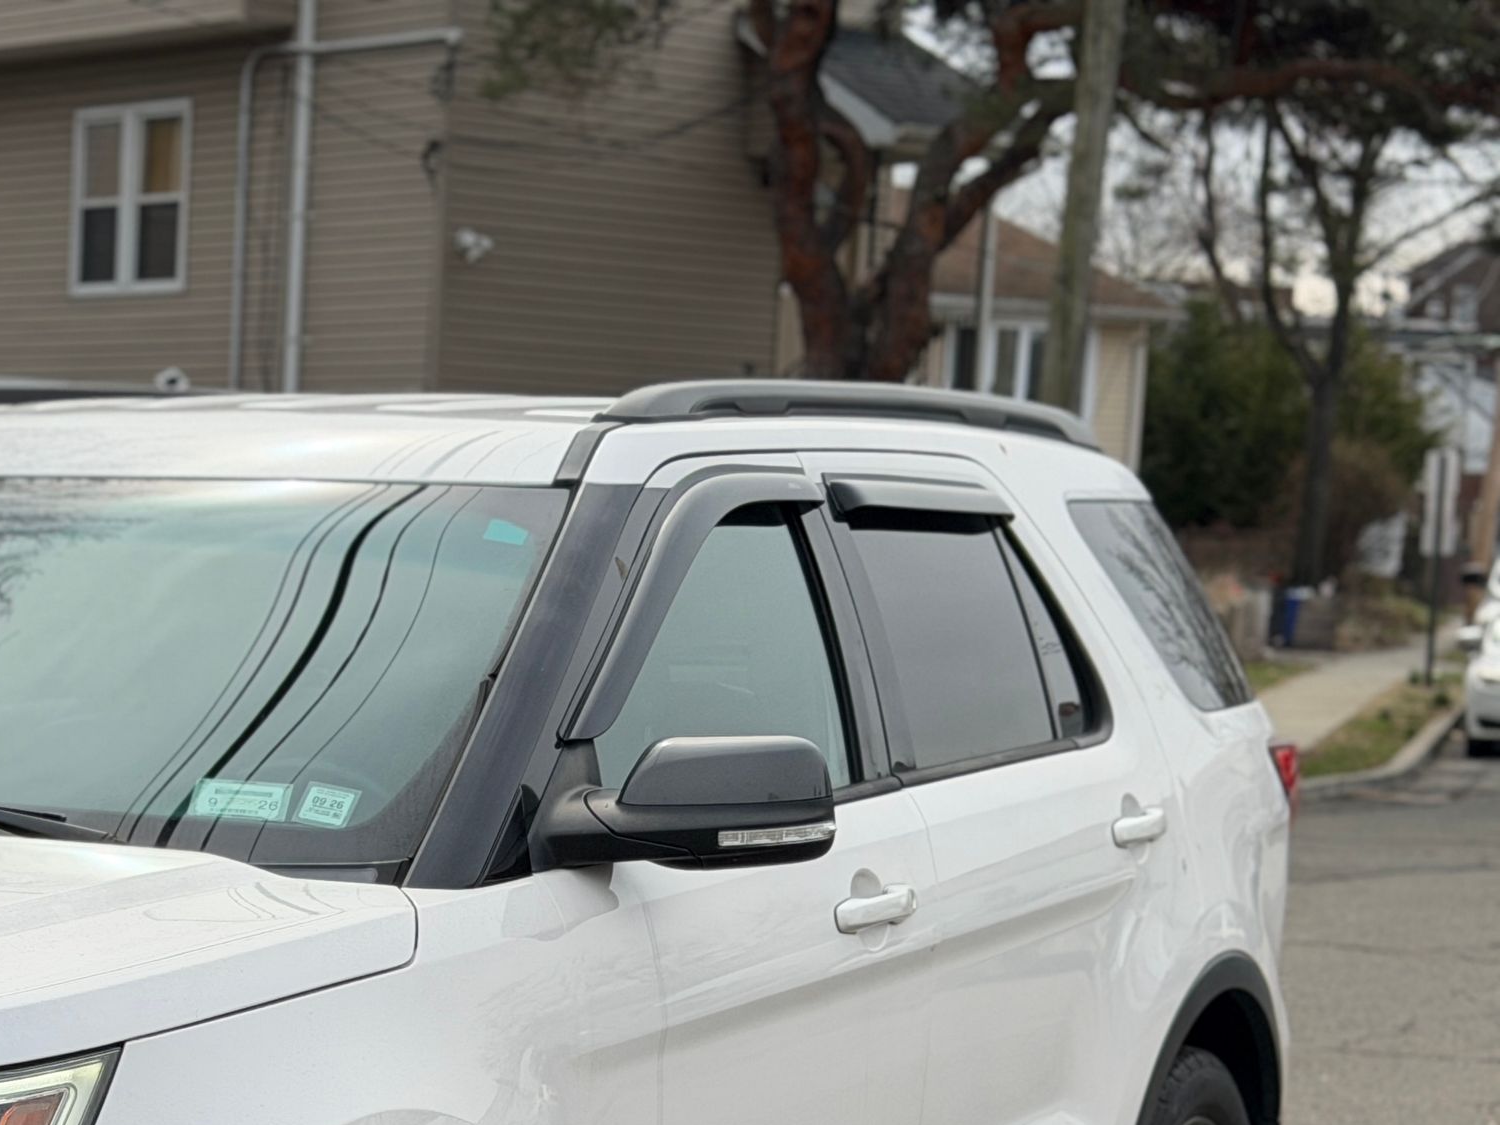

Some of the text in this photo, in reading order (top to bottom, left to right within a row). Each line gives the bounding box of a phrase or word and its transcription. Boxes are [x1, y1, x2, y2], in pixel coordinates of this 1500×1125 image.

[258, 800, 279, 811] 26
[312, 796, 345, 810] 09 26
